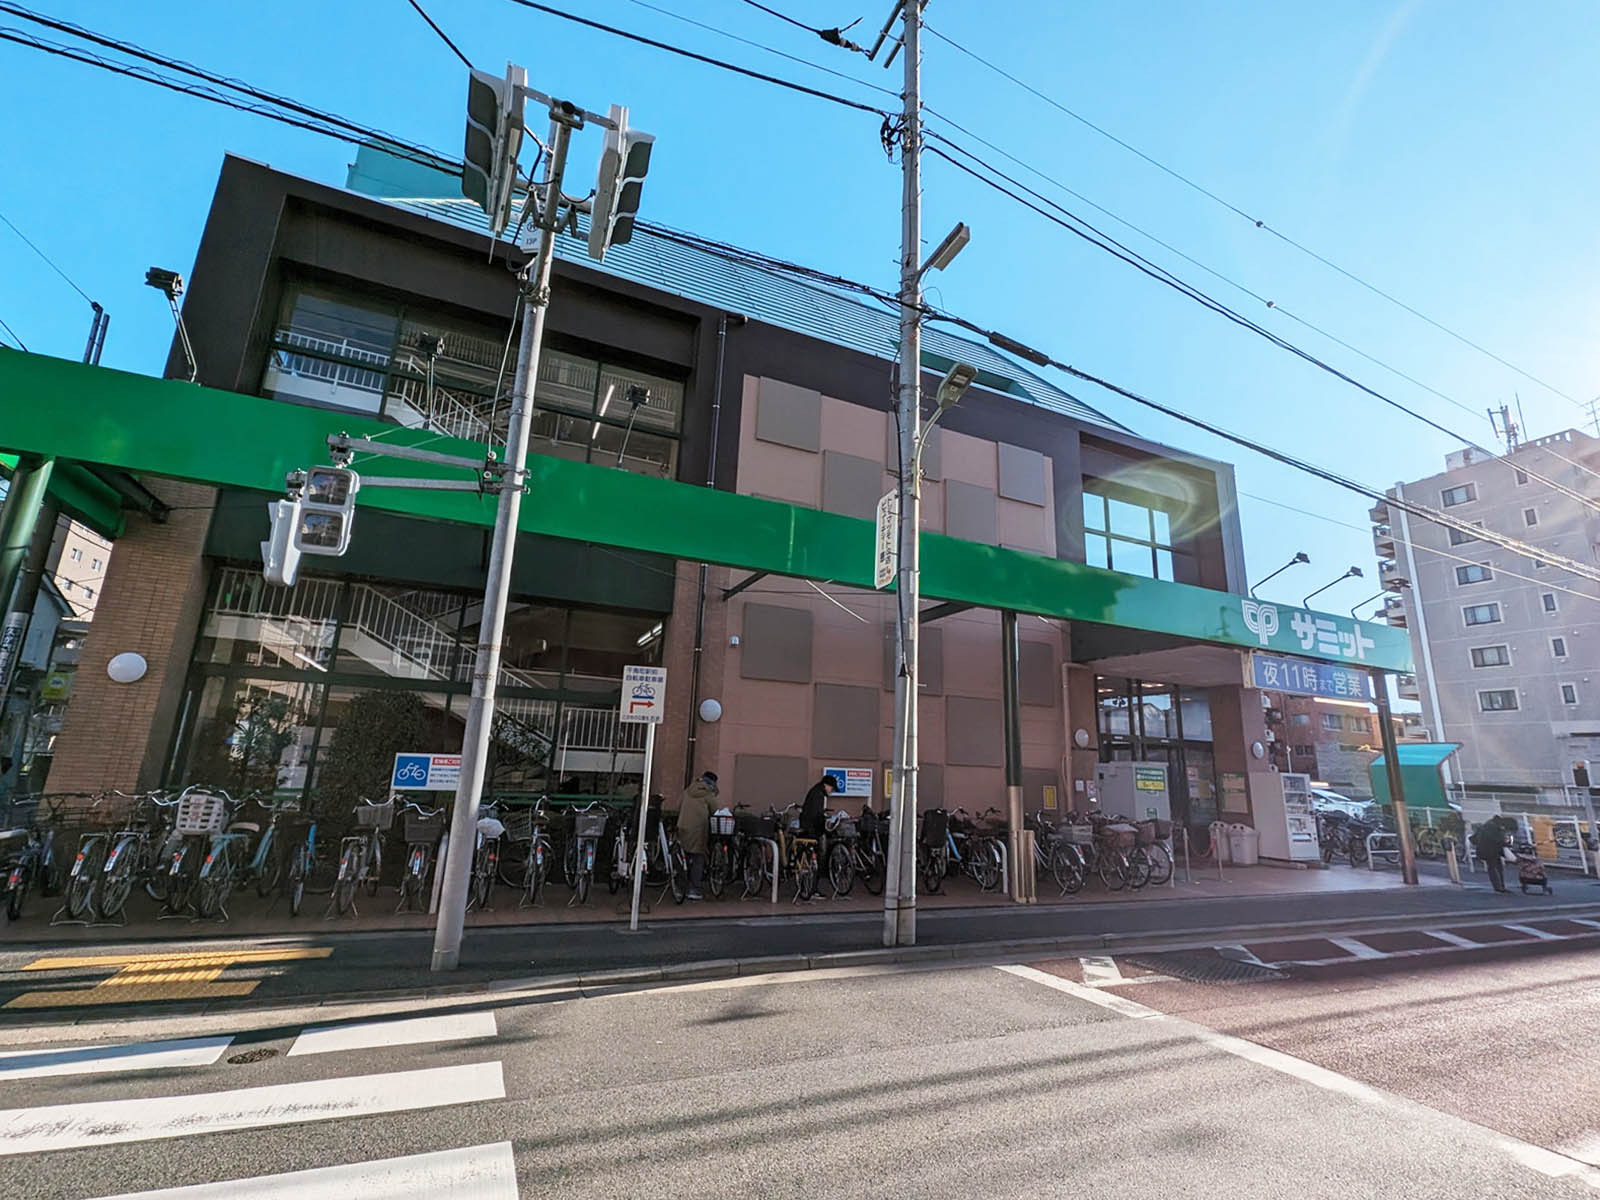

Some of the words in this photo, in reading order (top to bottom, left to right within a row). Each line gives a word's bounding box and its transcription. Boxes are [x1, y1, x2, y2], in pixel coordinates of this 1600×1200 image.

[1290, 611, 1375, 660] サミット
[1262, 661, 1363, 697] 夜11時まで営業
